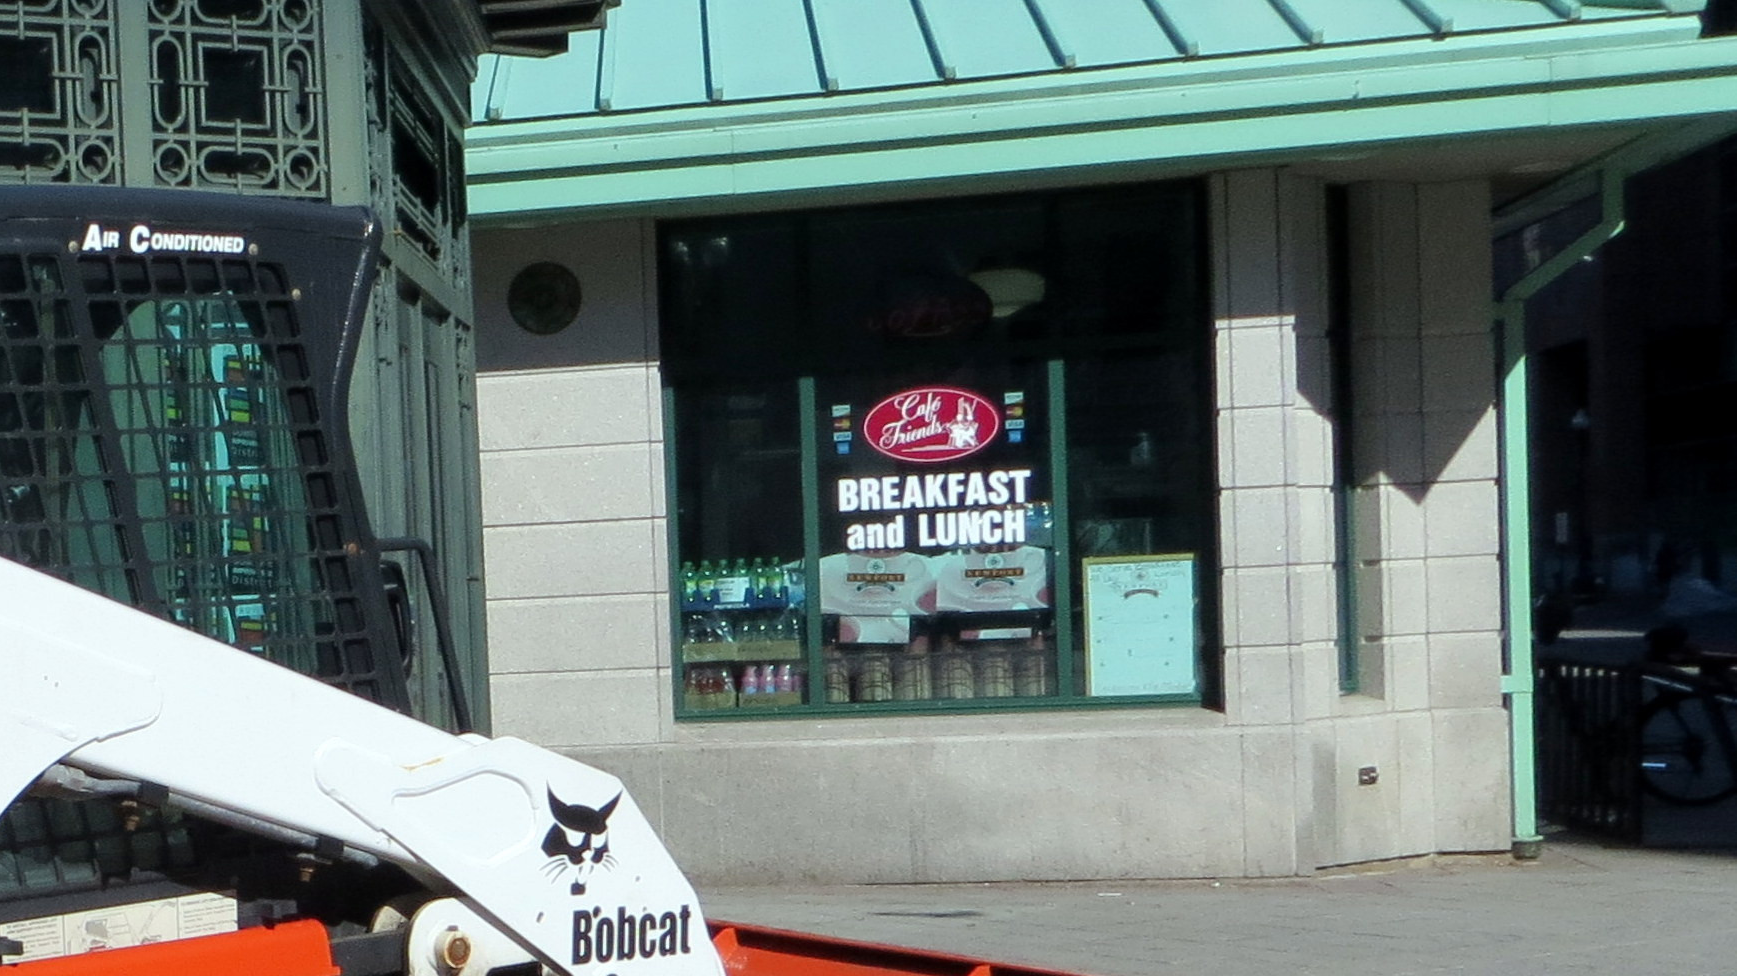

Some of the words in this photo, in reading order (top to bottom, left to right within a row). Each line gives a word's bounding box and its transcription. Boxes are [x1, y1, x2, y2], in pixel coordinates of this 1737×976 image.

[894, 391, 942, 423] Café
[879, 415, 947, 449] Friends
[838, 469, 1031, 512] BREAKFAST
[846, 515, 904, 550] and
[918, 509, 1025, 547] LUNCH
[572, 904, 691, 965] Bobcat
